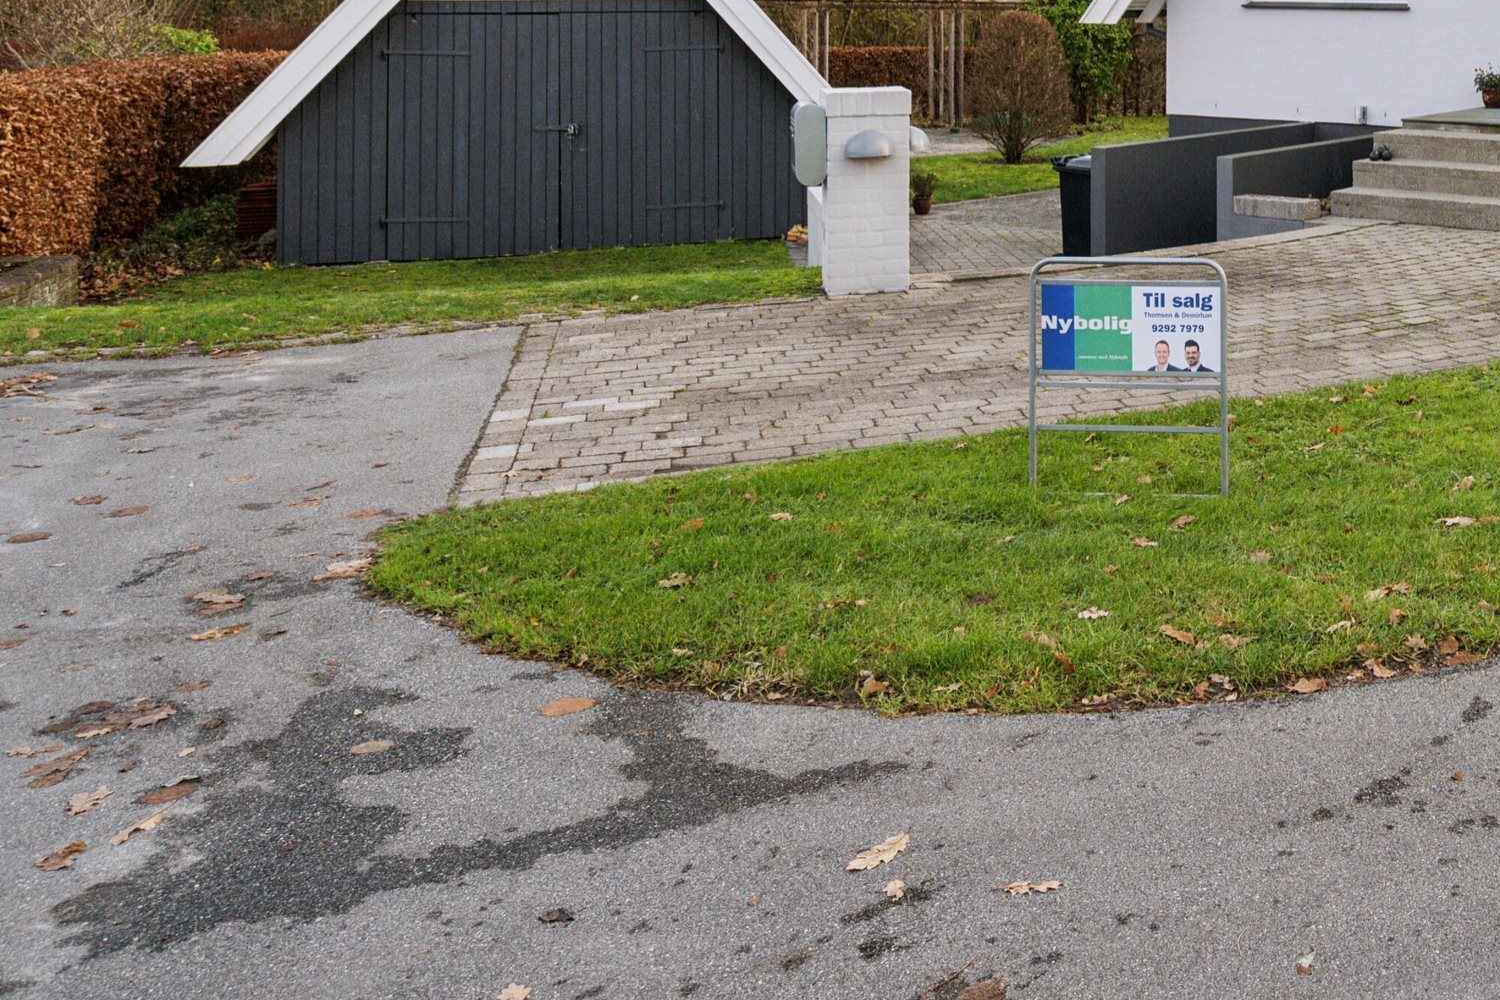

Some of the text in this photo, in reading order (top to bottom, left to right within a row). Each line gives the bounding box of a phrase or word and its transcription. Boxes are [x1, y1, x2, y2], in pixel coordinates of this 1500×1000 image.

[1143, 293, 1213, 312] Til salg
[1041, 315, 1132, 334] Nybolig
[1151, 324, 1205, 333] 9292 7979
